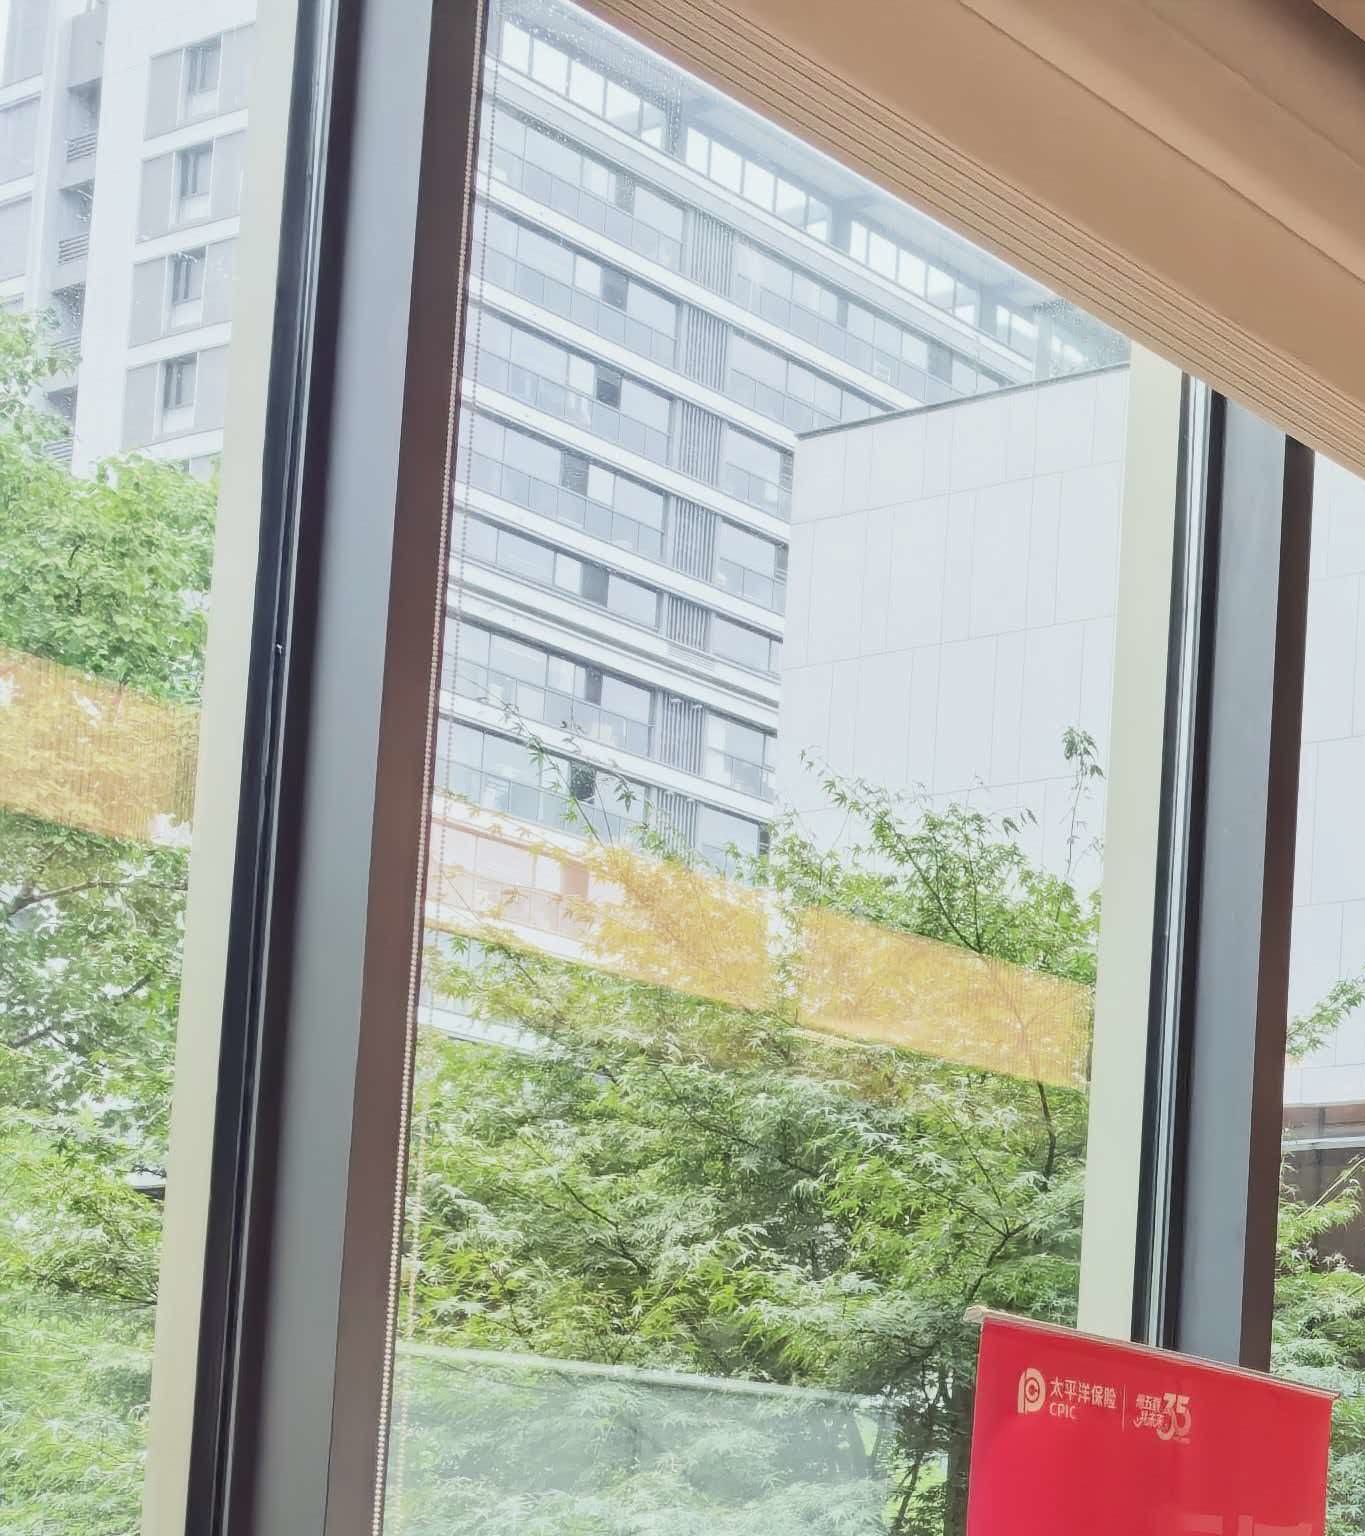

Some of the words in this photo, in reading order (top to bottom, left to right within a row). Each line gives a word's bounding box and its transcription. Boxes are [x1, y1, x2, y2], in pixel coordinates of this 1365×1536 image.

[1050, 1376, 1117, 1409] 太平洋保险
[1049, 1402, 1078, 1420] CPIC
